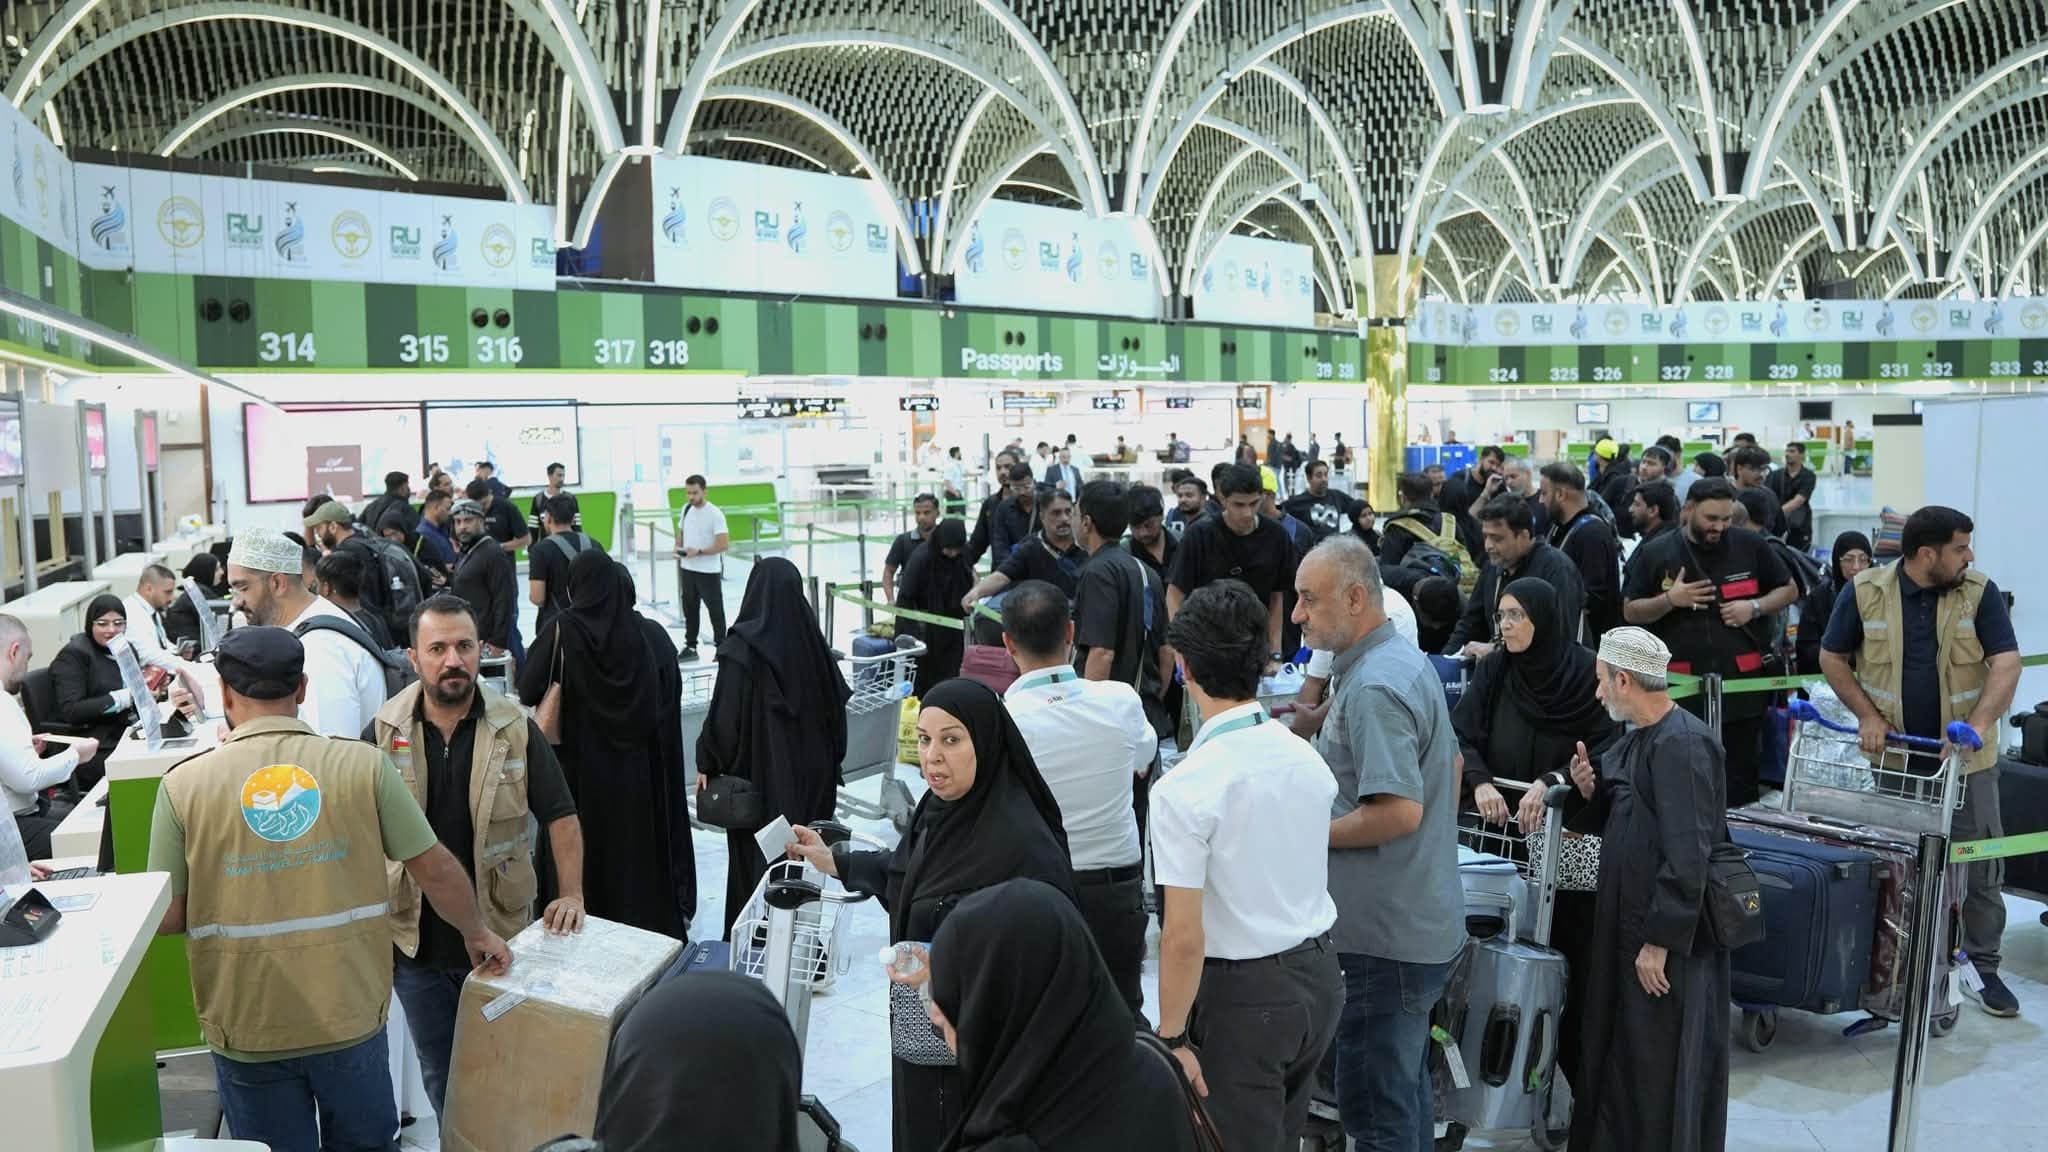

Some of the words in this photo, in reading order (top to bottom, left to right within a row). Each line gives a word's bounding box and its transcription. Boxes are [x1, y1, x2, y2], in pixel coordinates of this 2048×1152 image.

[226, 213, 263, 233] RU
[754, 210, 779, 230] RU
[390, 225, 421, 245] RU
[260, 332, 317, 362] 314
[399, 334, 450, 363] 315
[477, 335, 523, 363] 316
[594, 339, 636, 364] 317
[649, 340, 689, 365] 318
[961, 348, 1063, 374] Passports
[1989, 360, 2021, 376] 333
[1488, 367, 1518, 382] 324
[1550, 367, 1579, 382] 325
[1593, 366, 1622, 382] 326
[1661, 366, 1691, 381] 327
[1703, 365, 1734, 380] 328
[1768, 364, 1798, 379] 329
[1811, 364, 1842, 379] 330
[1880, 363, 1909, 378] 331
[1921, 363, 1952, 378] 332
